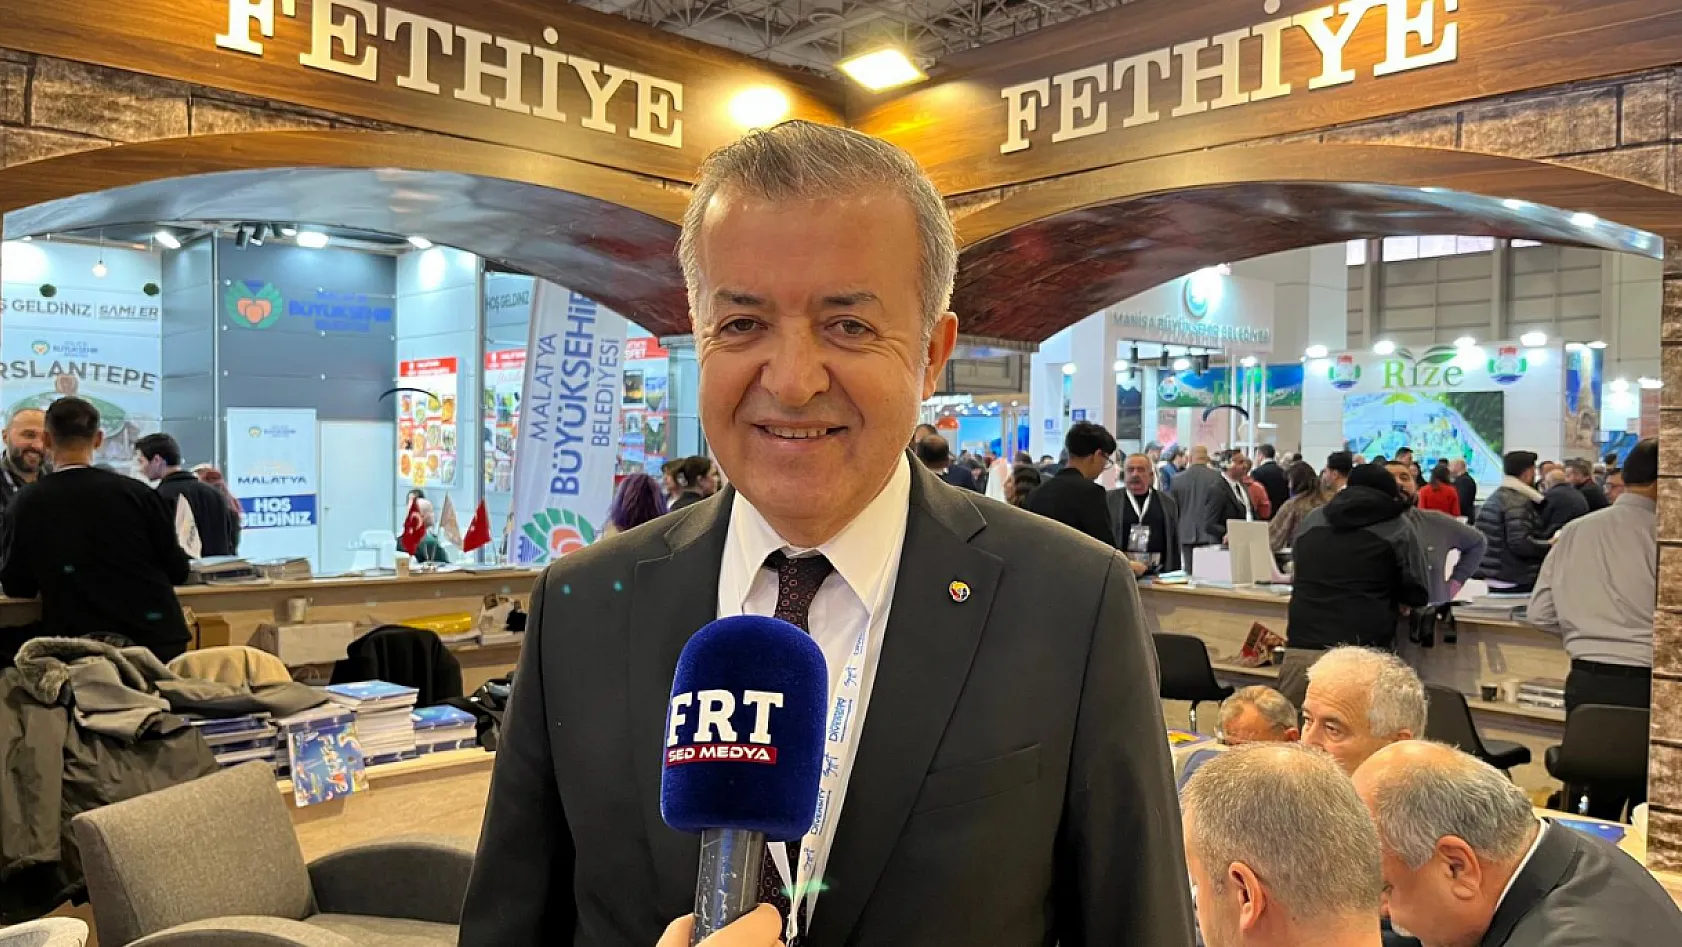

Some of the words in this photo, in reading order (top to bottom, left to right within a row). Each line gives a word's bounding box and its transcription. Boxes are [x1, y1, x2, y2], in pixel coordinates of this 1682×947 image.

[999, 0, 1459, 154] FETHİYE
[528, 334, 557, 442] MALATYA
[590, 338, 620, 447] BELEDİYESİ
[238, 475, 307, 485] MALATYA
[666, 689, 784, 747] FRT
[669, 747, 696, 762] SED
[699, 746, 771, 761] MEDYA
